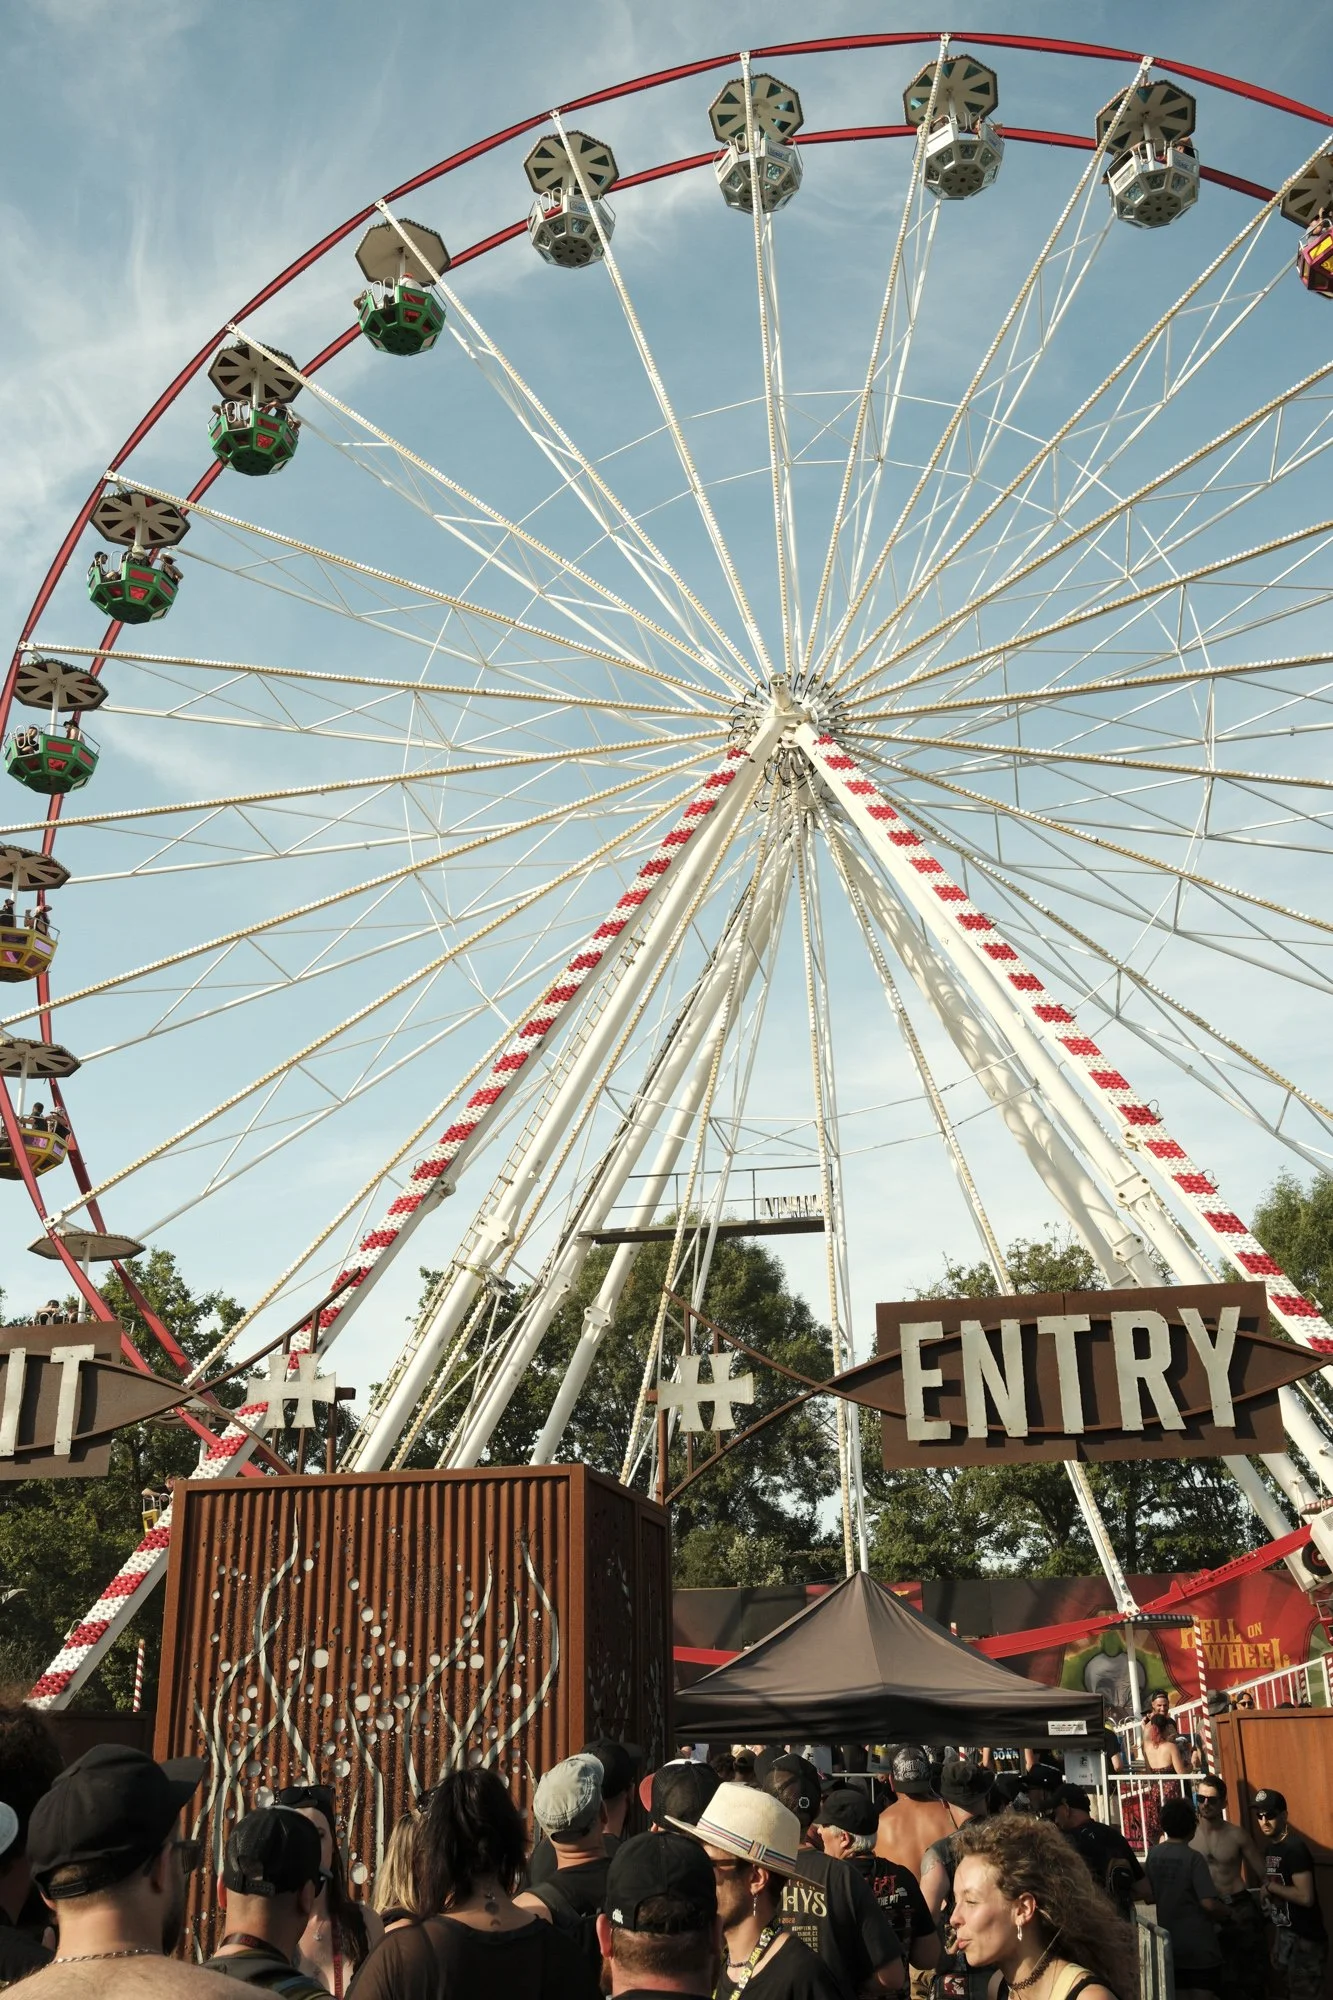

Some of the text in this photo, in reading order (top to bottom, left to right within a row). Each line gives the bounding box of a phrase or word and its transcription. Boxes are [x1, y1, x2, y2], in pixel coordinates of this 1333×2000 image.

[899, 1306, 1241, 1441] ENTRY
[1180, 1618, 1262, 1649] HELL ON
[889, 1894, 899, 1904] PIT
